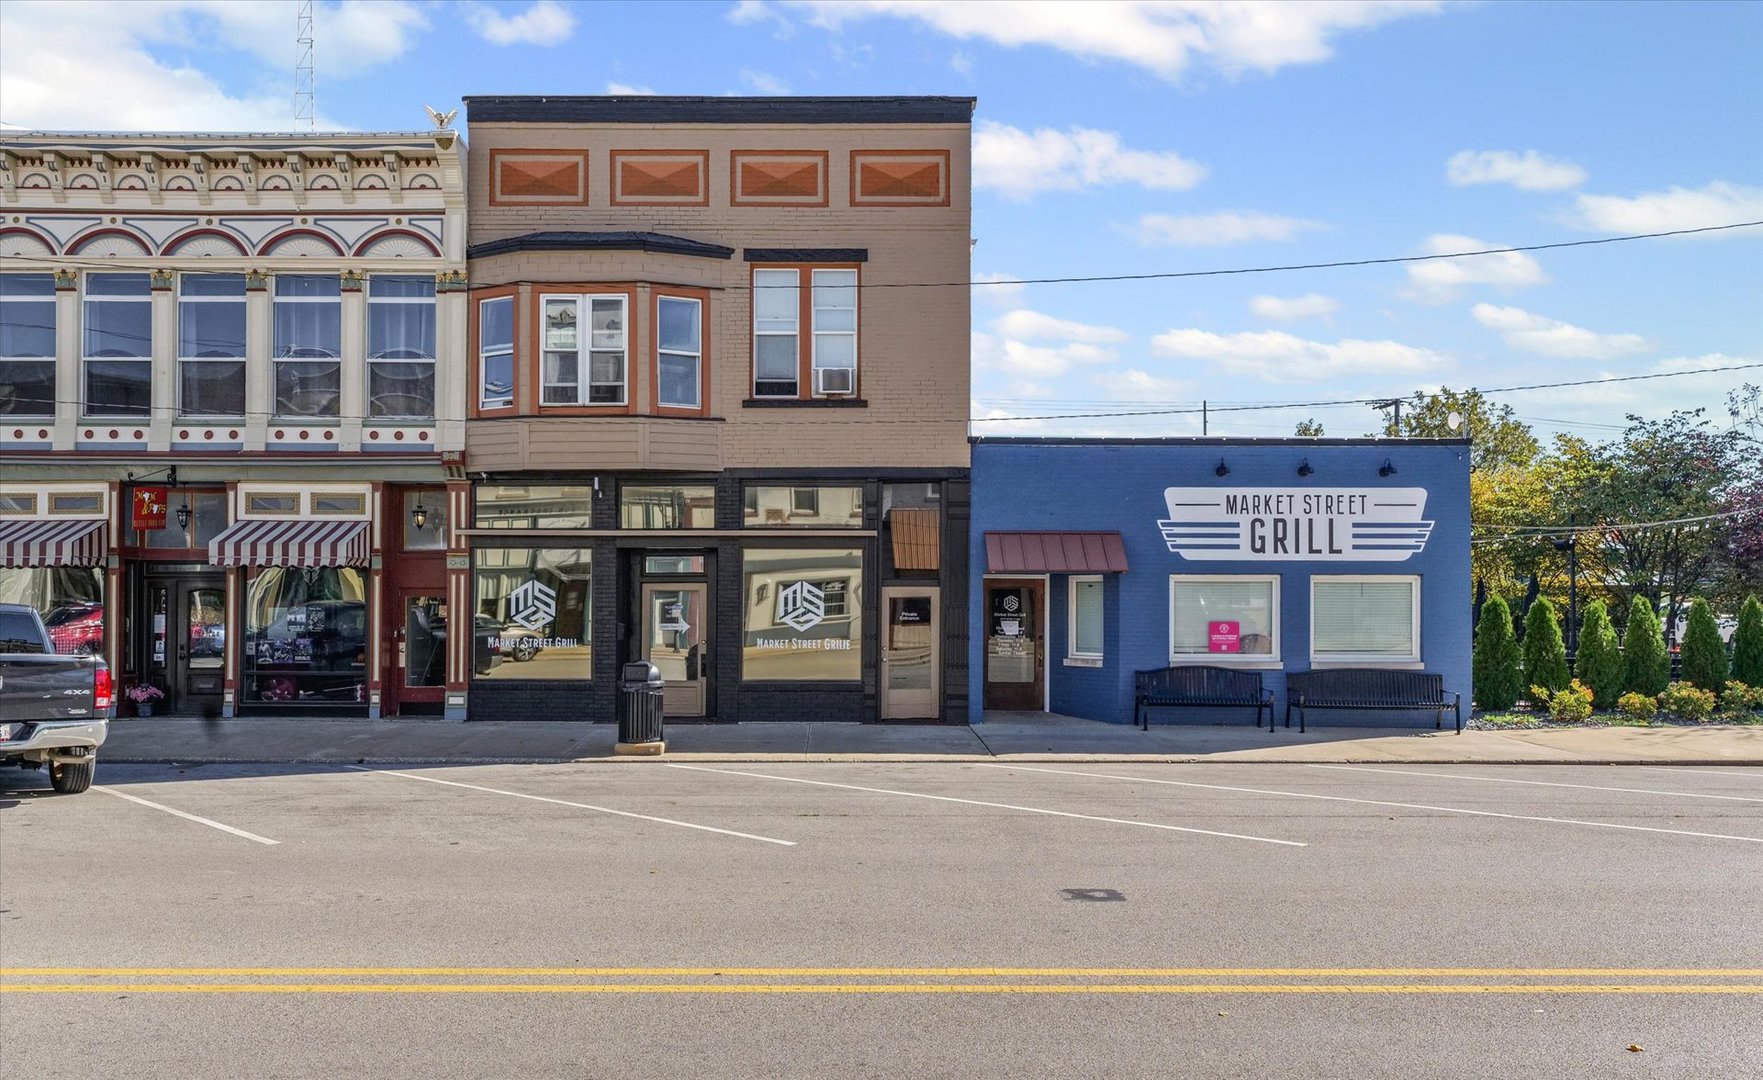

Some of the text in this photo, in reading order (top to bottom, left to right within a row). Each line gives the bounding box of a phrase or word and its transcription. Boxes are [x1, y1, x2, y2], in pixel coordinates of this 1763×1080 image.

[1226, 494, 1367, 515] MARKET STREET
[1250, 518, 1343, 554] GRILL
